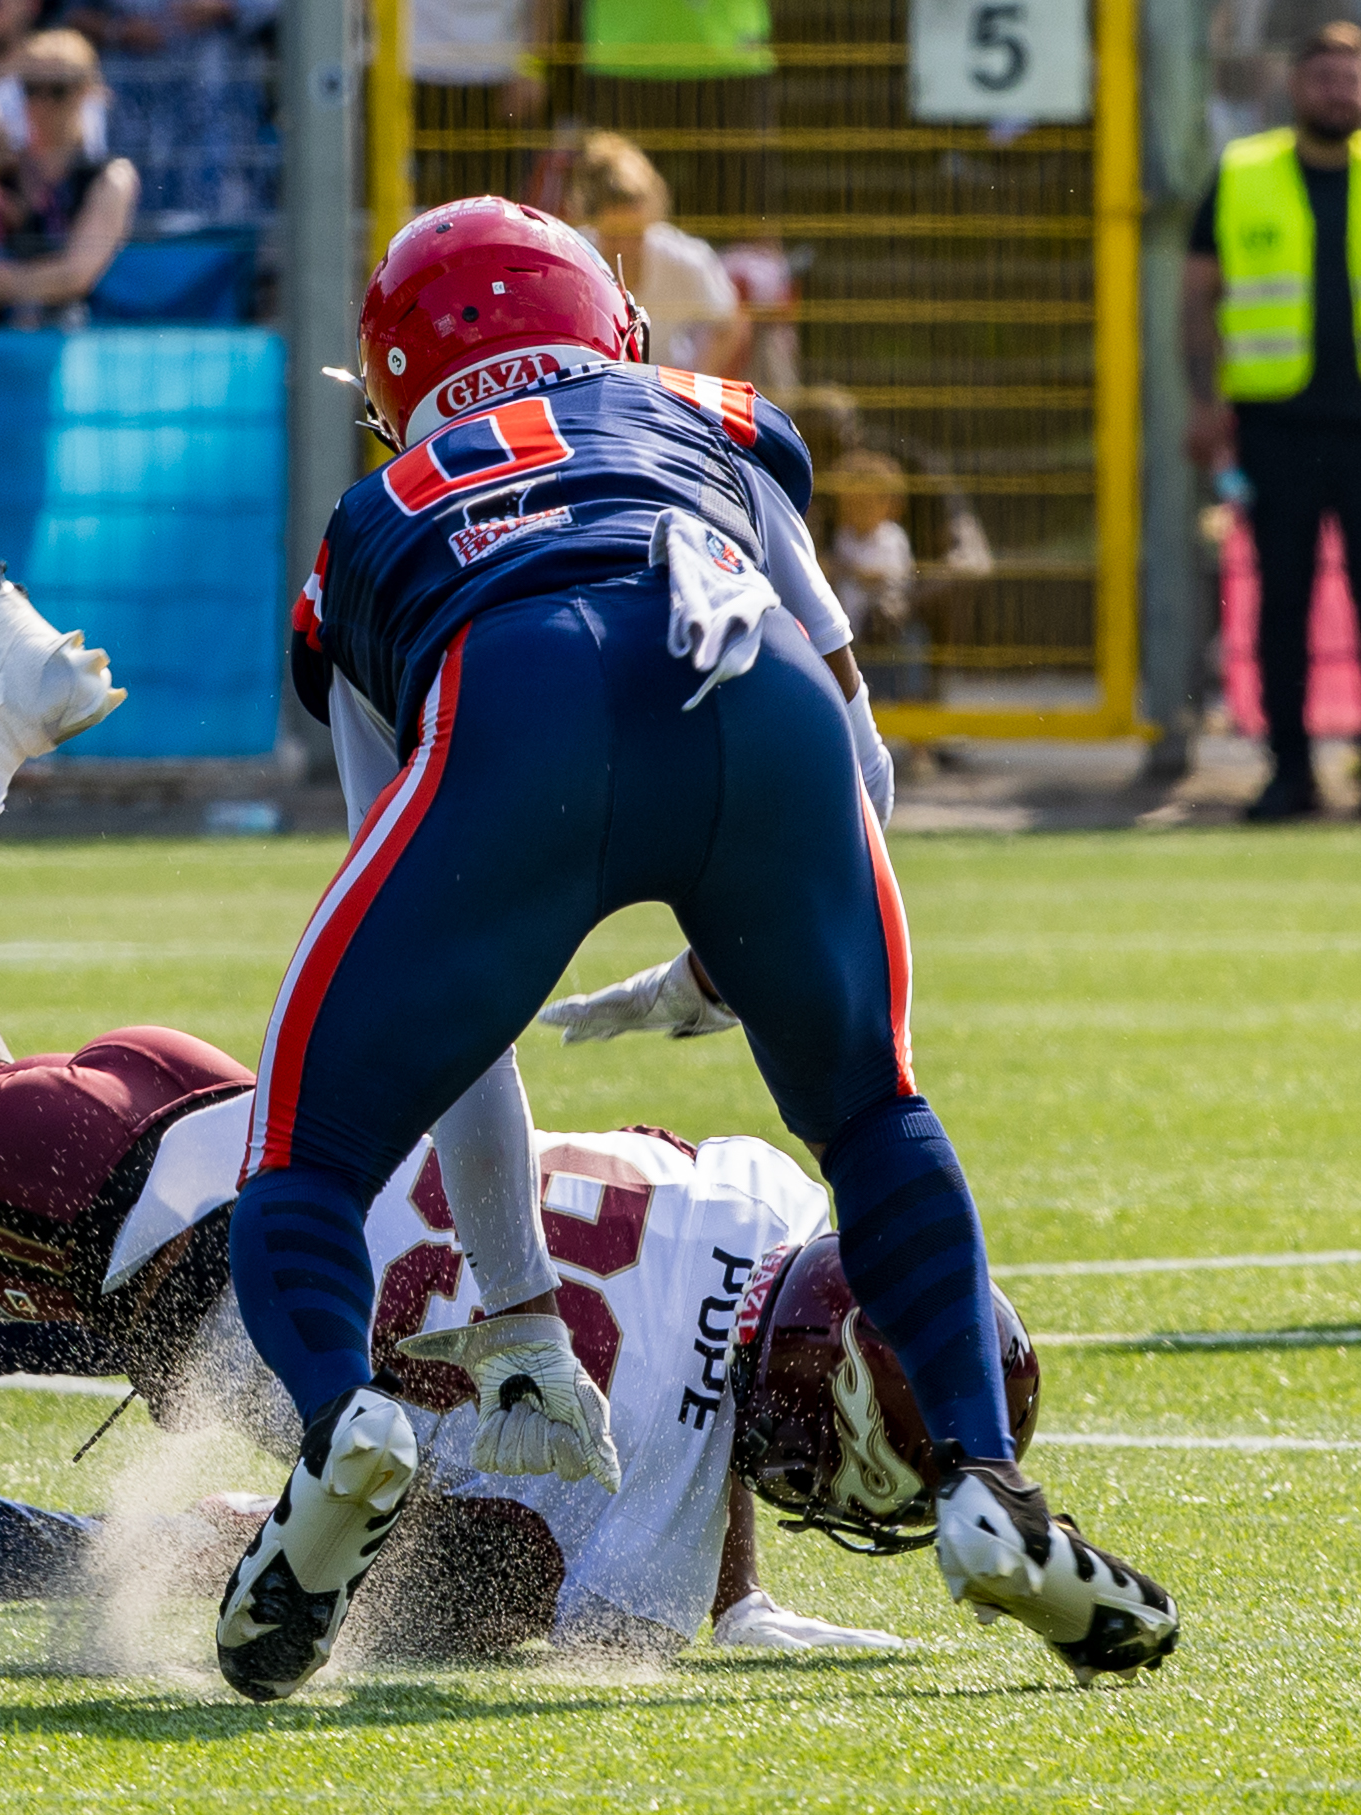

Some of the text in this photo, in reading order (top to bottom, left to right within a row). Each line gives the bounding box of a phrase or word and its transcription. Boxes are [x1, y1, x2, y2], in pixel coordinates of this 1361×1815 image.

[970, 6, 1029, 91] 5
[446, 354, 545, 411] GAZI
[677, 1245, 755, 1430] POPE
